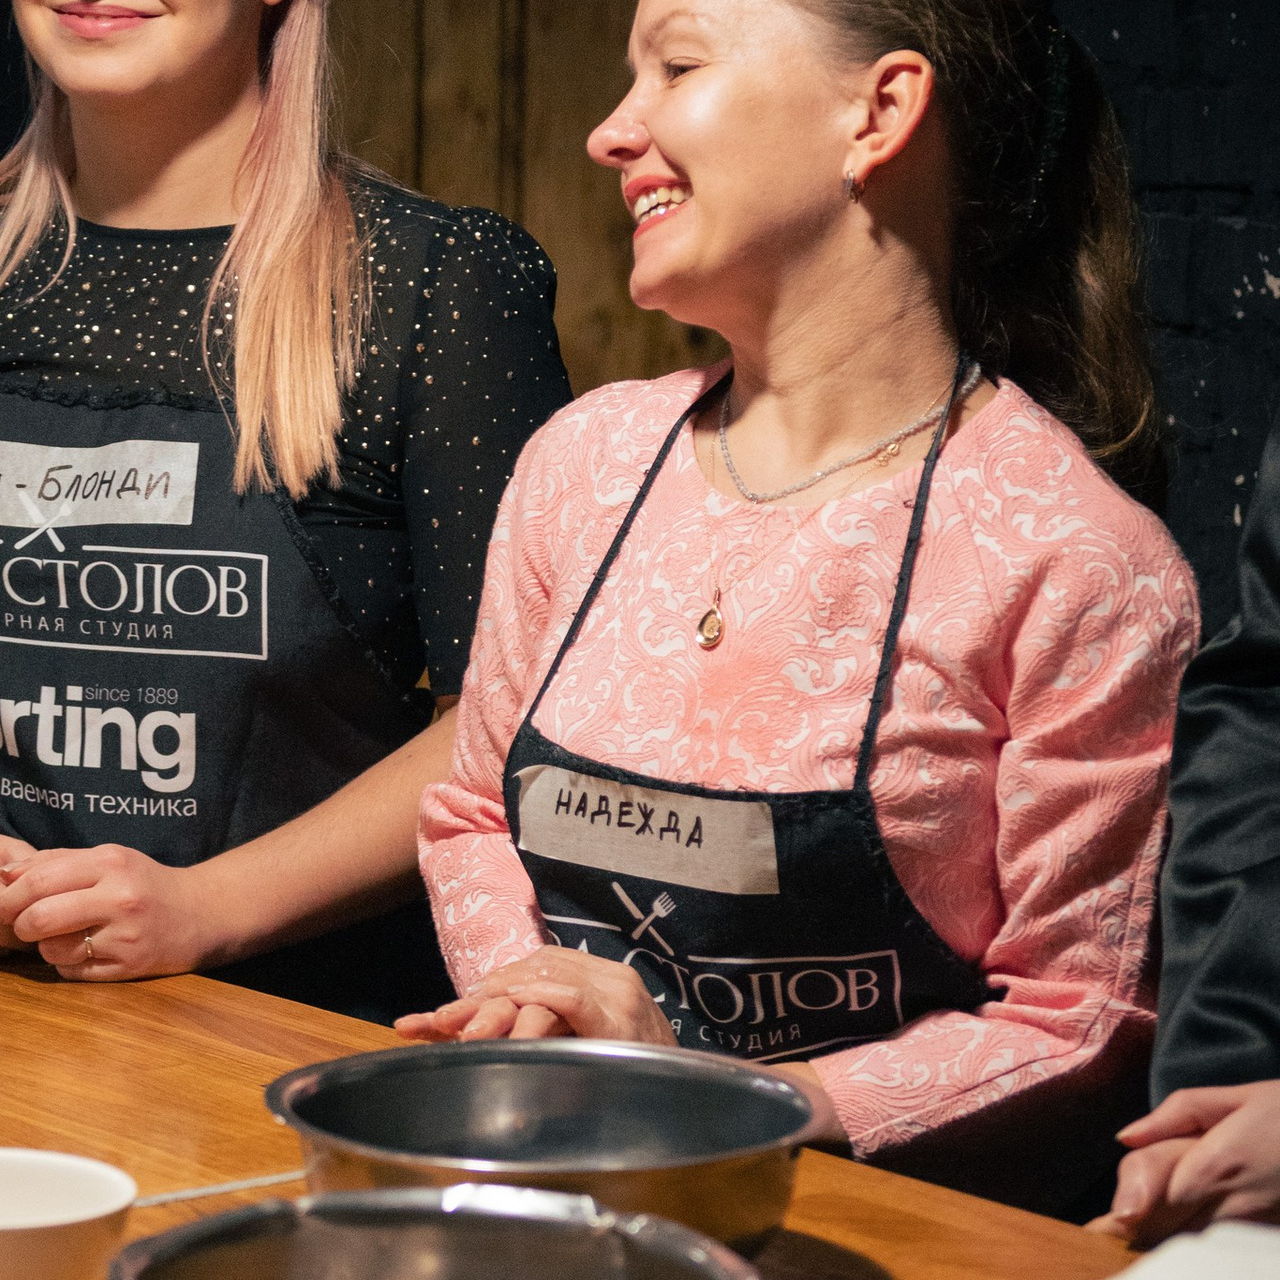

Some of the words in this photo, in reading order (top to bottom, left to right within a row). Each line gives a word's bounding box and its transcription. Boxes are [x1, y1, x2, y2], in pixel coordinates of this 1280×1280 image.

[1, 556, 250, 618] СТОЛОВ
[79, 619, 174, 641] СТУДИЯ
[84, 684, 131, 703] since
[136, 687, 179, 706] 1889
[84, 793, 198, 817] техника
[554, 787, 705, 849] НАДЕЖДА
